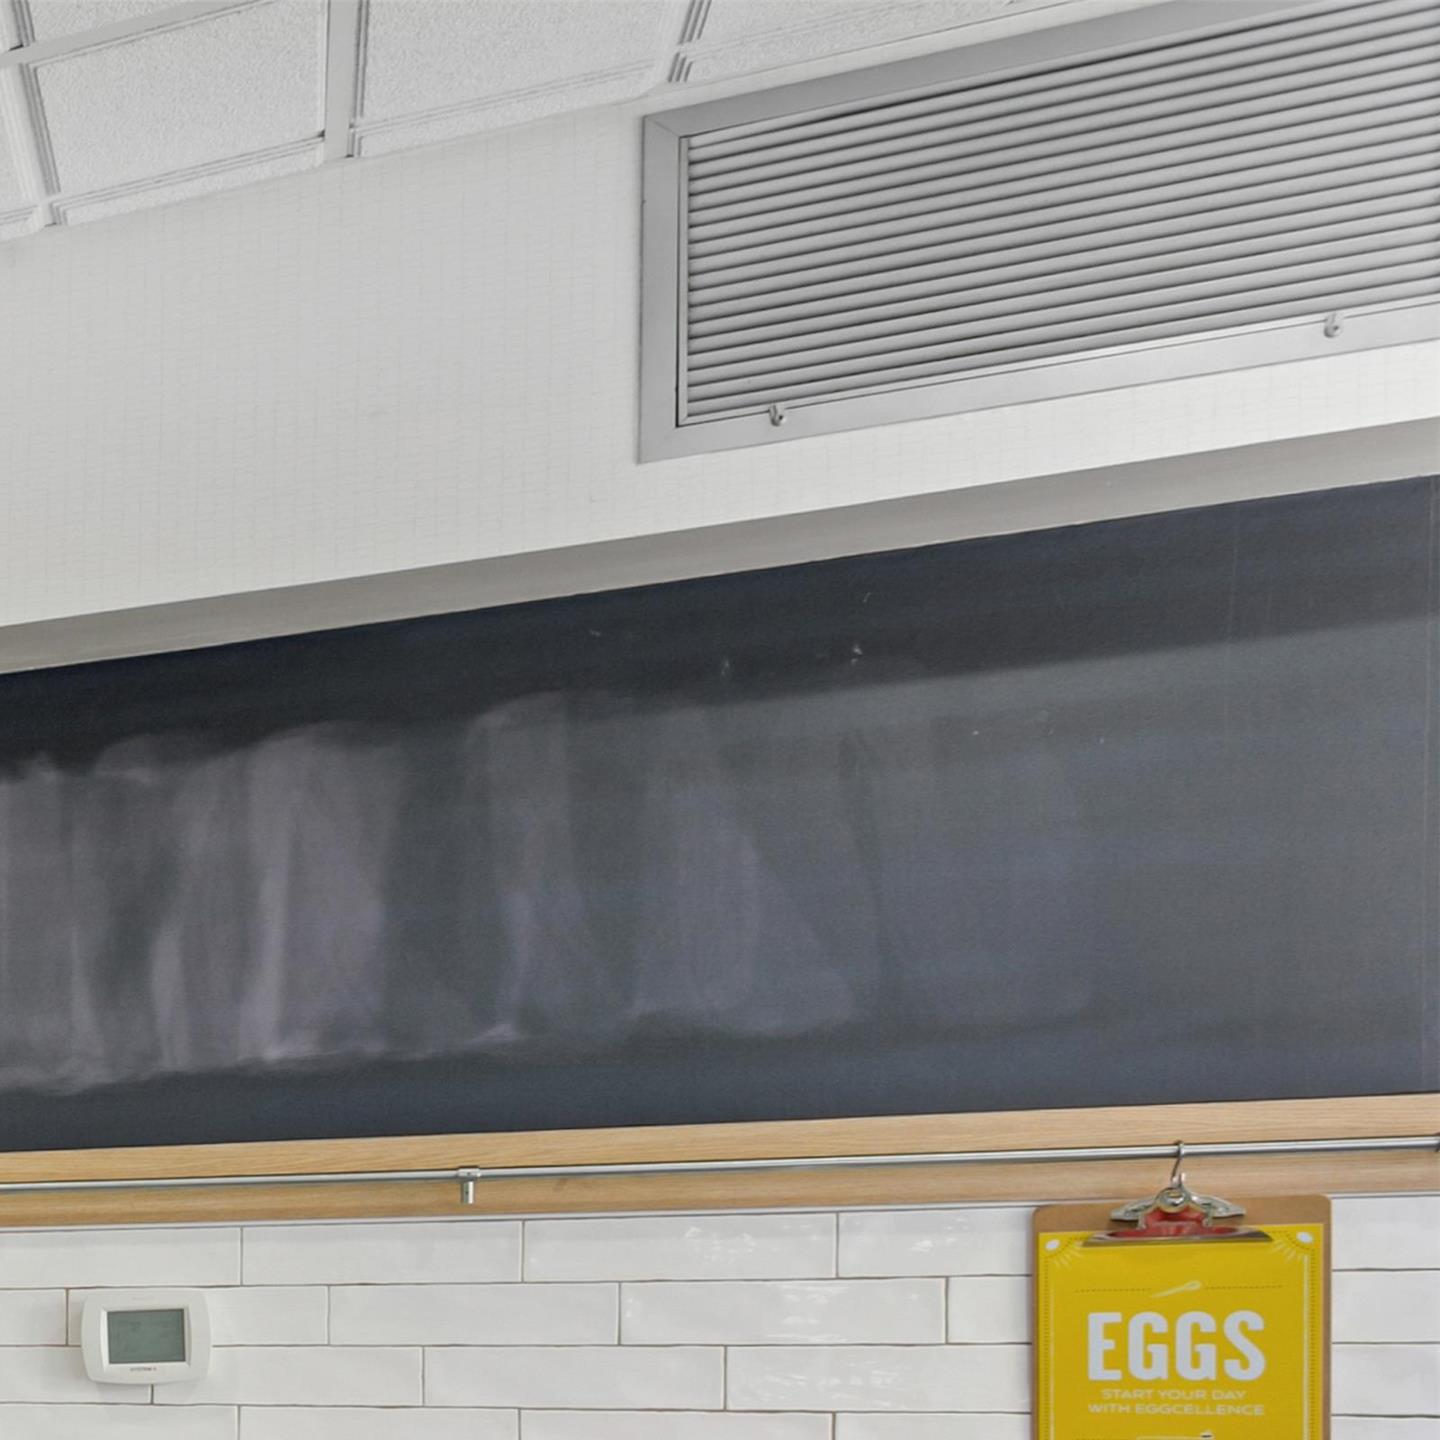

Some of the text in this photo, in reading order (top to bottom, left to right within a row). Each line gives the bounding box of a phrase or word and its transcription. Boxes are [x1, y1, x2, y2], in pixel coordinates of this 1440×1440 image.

[1088, 1310, 1265, 1381] EGGS
[1102, 1388, 1246, 1400] START YOUR DAY
[1088, 1403, 1265, 1416] WITH EGGCELLENCE
